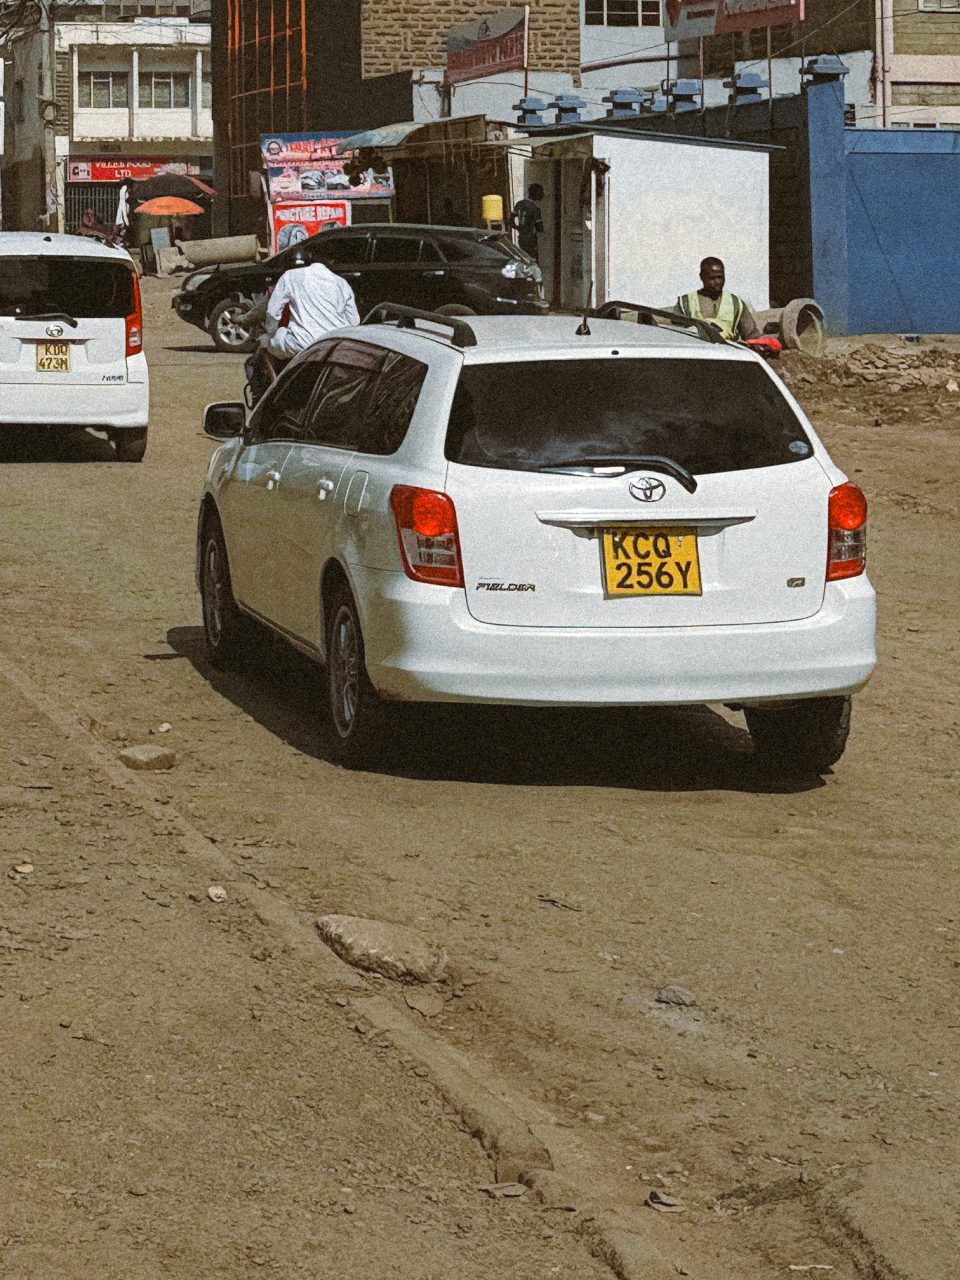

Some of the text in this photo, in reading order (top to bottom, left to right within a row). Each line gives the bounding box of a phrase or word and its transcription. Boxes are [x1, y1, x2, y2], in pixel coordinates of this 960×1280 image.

[611, 531, 672, 560] KCQ
[476, 582, 535, 592] FIELDER
[615, 561, 692, 589] 256Y
